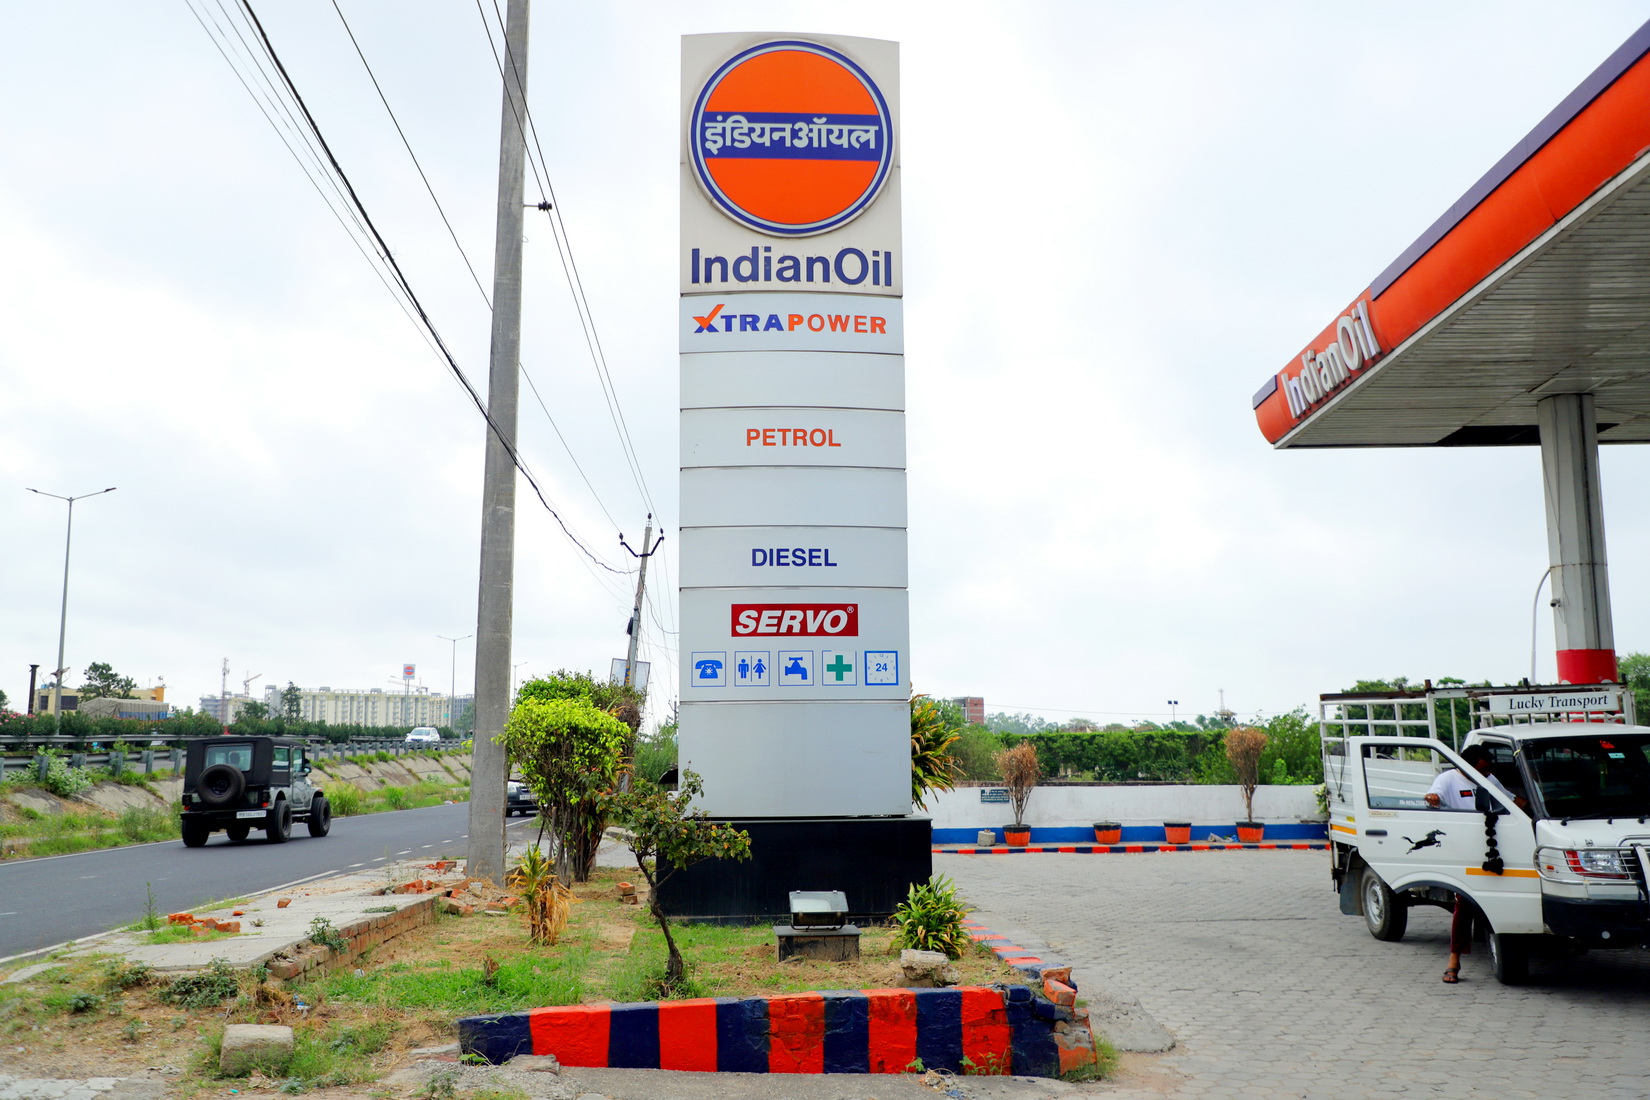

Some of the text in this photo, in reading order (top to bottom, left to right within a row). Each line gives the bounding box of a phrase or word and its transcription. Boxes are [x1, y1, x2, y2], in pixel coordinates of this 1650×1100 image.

[704, 115, 879, 155] इंडियनऑयल
[691, 246, 892, 287] IndianOil
[1281, 299, 1381, 419] IndianOil
[746, 428, 842, 447] PETROL
[751, 548, 838, 567] DIESEL
[875, 662, 888, 672] 24
[1509, 694, 1608, 710] Lucky Transport
